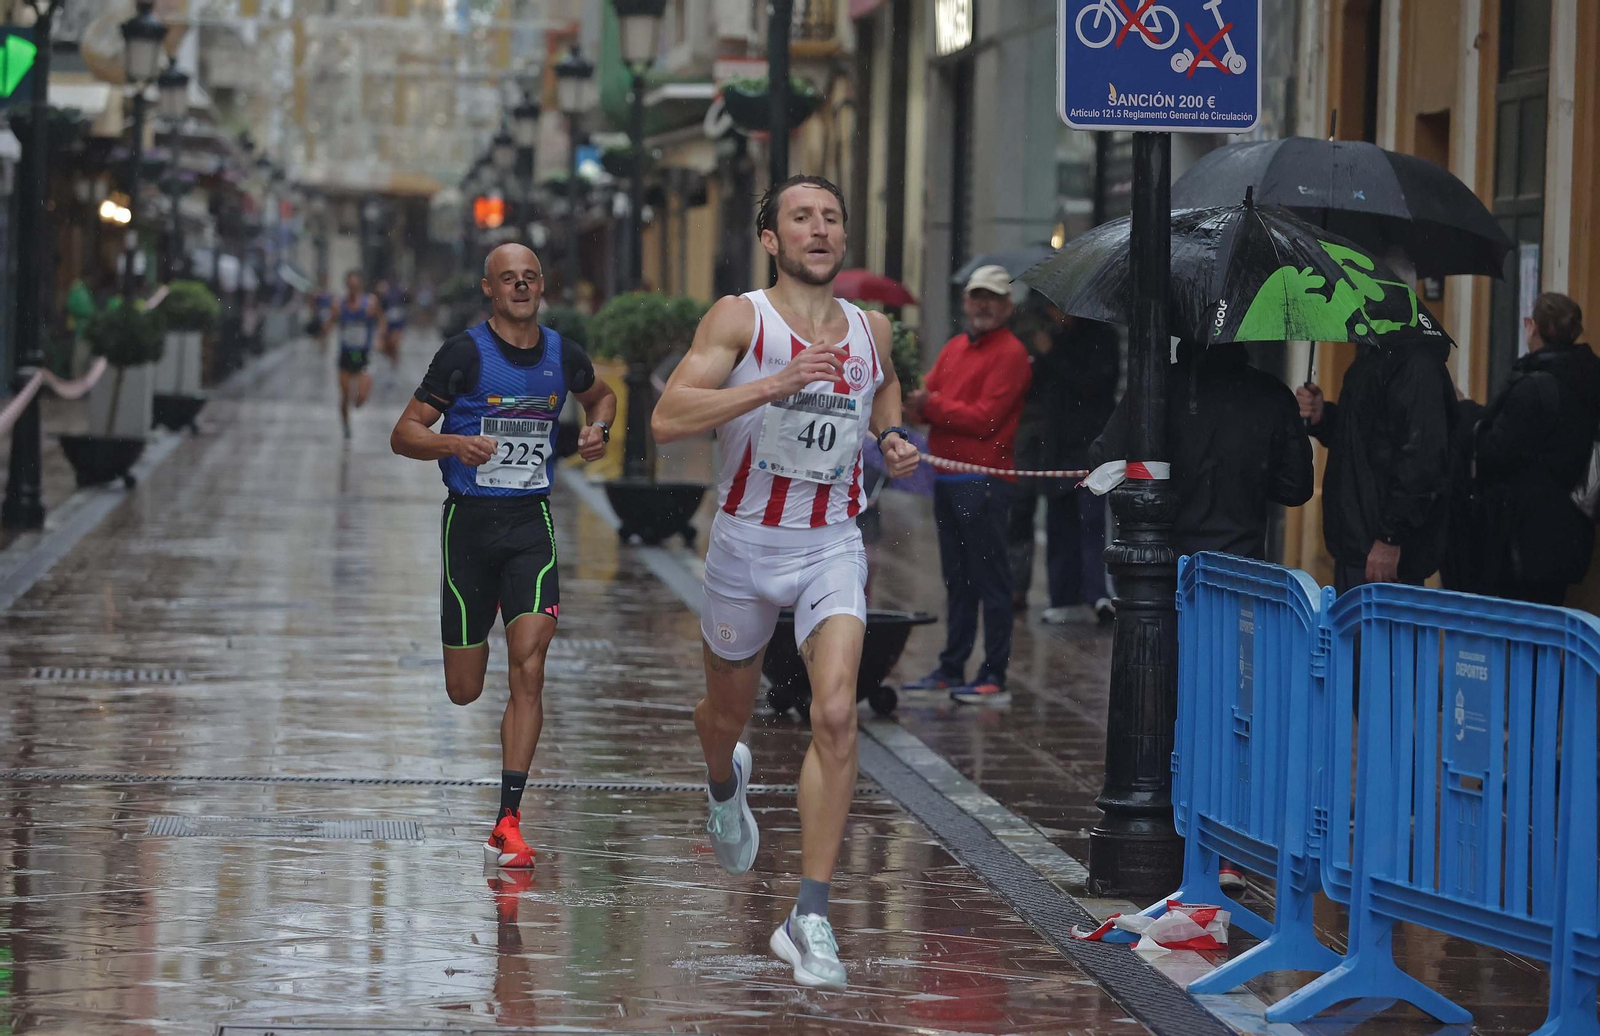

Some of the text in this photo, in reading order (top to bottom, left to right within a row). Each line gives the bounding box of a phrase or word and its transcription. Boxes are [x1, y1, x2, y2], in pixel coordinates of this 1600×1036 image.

[1108, 91, 1216, 108] SANCIÓN 200 €
[1070, 108, 1253, 121] Artículo 121.5 Reglamento General de Circulación
[798, 420, 836, 451] 40
[500, 442, 545, 466] 225
